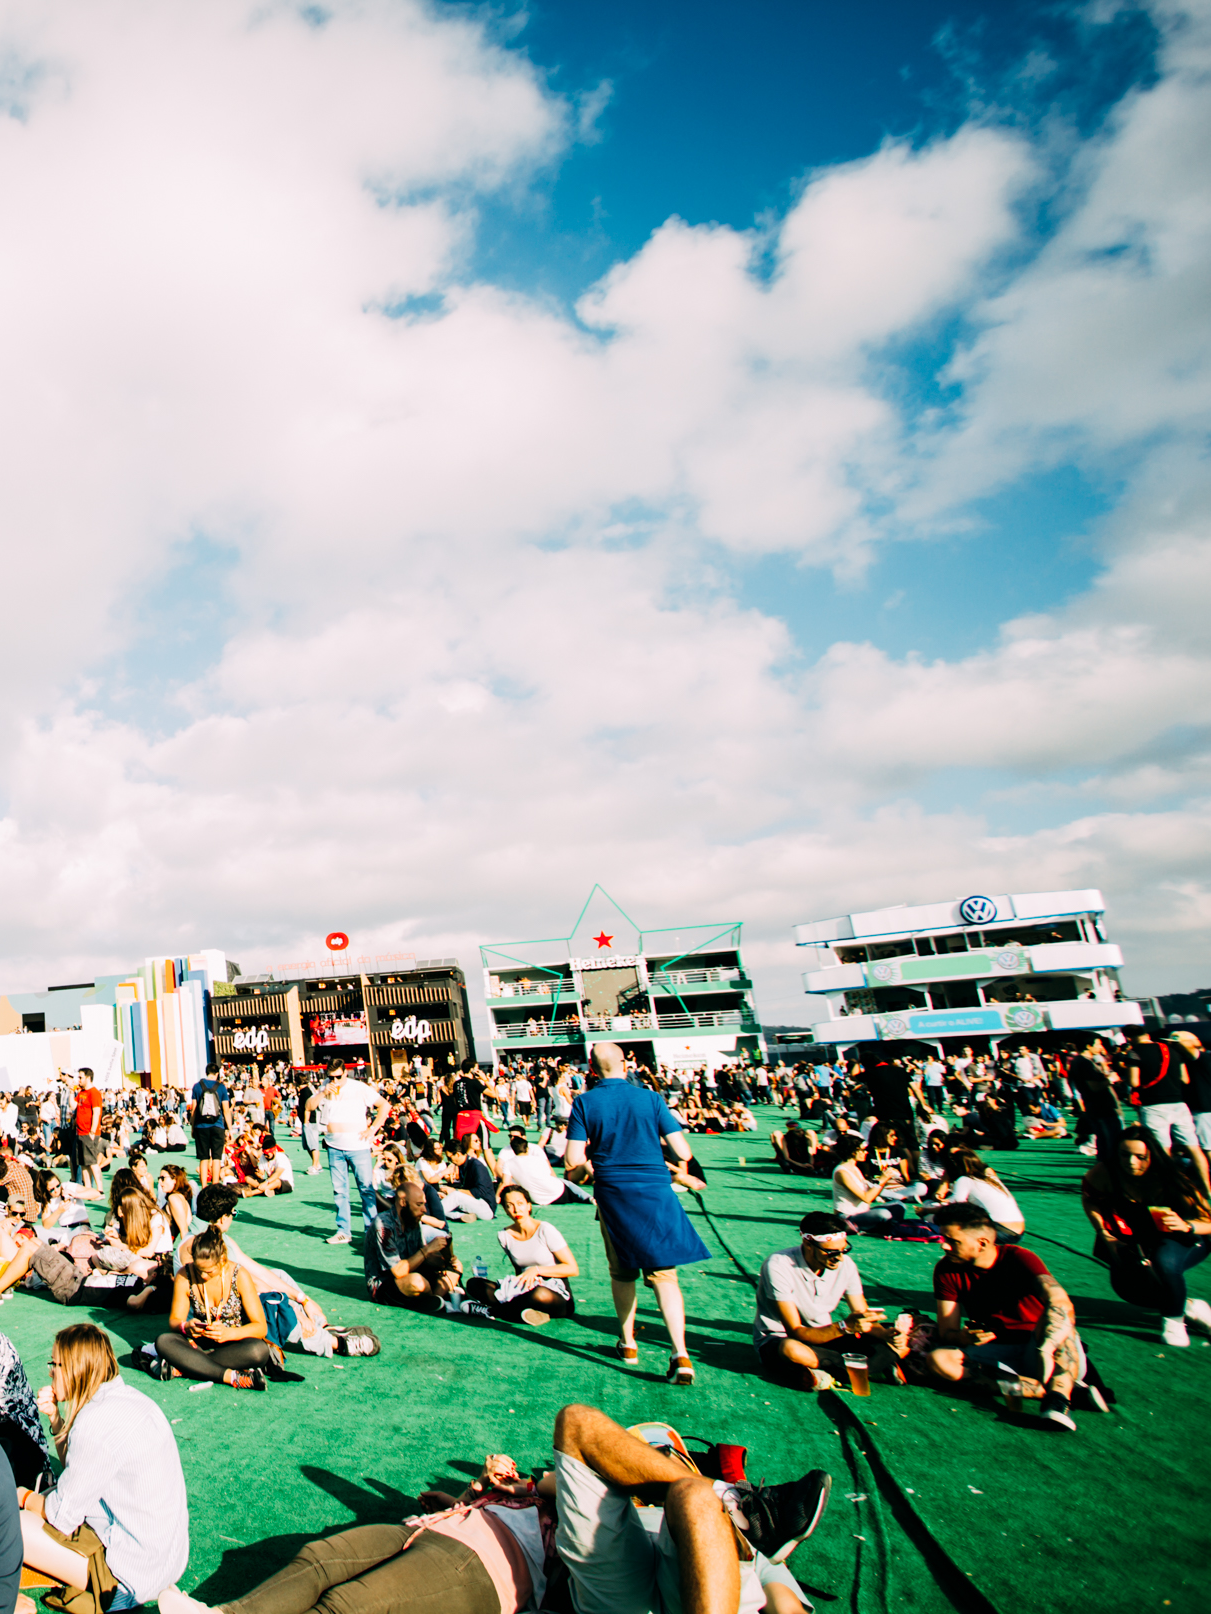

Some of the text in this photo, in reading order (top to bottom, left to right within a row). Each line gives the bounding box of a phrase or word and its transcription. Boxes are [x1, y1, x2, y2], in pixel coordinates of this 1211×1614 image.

[331, 937, 343, 946] edp
[277, 960, 316, 971] energia
[320, 955, 352, 967] oficial
[357, 954, 371, 964] da
[375, 951, 416, 962] música
[233, 1025, 269, 1053] edp
[391, 1015, 432, 1045] edp
